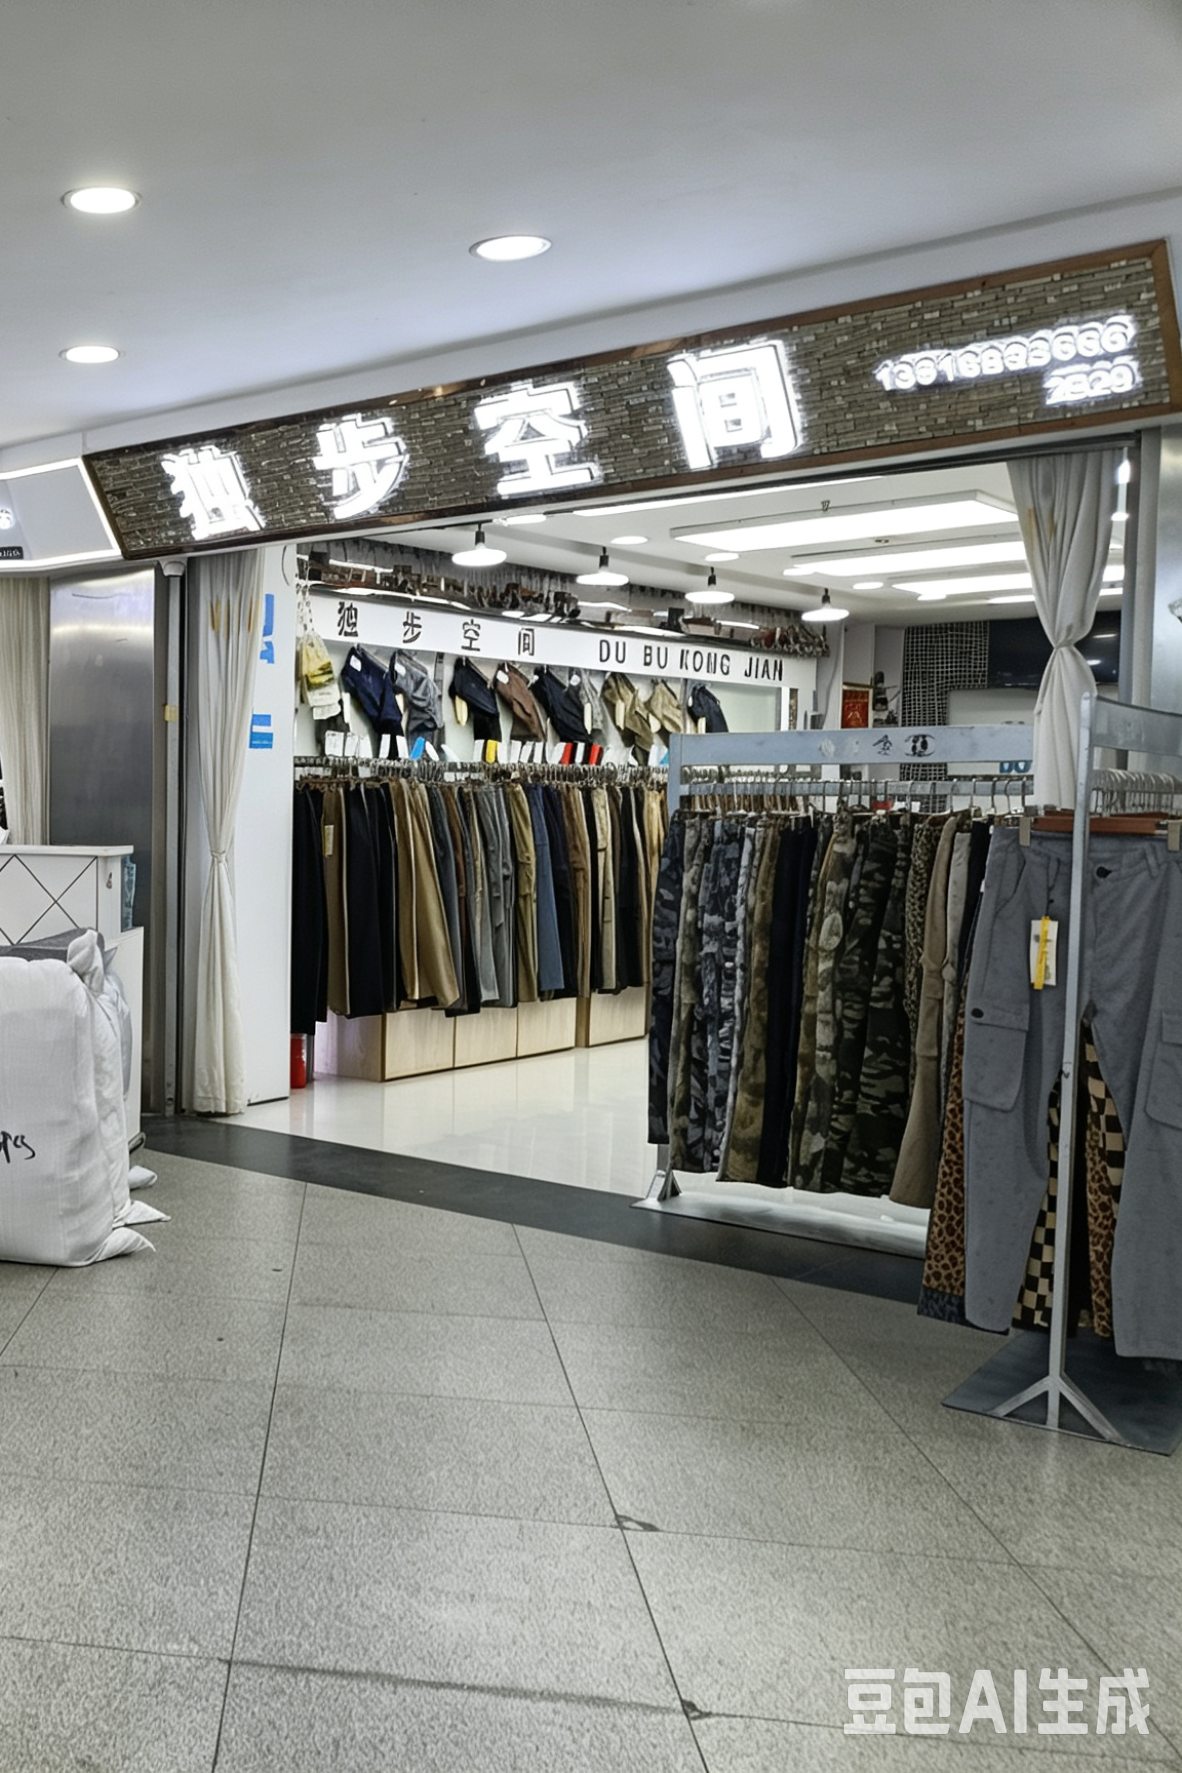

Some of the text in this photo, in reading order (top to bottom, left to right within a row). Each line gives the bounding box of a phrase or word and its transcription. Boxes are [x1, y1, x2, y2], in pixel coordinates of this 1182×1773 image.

[161, 339, 803, 542] 独步空间
[337, 601, 536, 657] 独步空间
[598, 638, 784, 682] DU BU KONG JIAN
